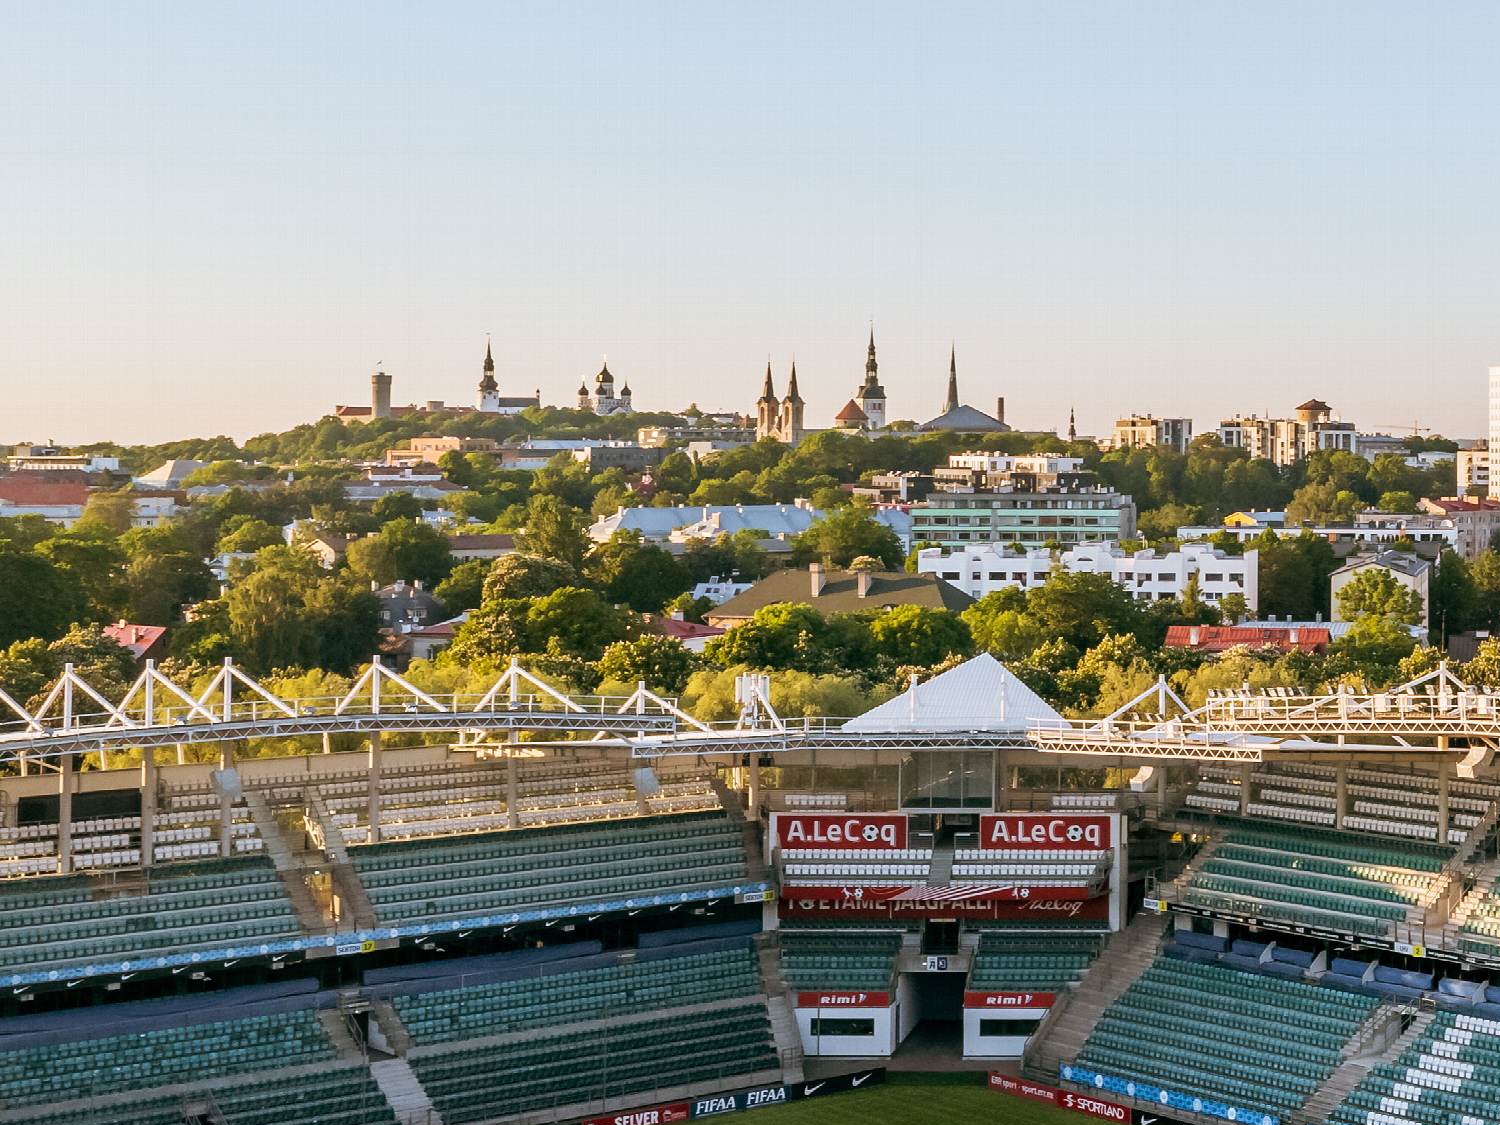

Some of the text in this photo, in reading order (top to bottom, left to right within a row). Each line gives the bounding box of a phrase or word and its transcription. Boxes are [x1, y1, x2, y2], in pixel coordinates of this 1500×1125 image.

[696, 1096, 736, 1114] FIFAA
[747, 1088, 786, 1105] FIFAA
[1077, 1098, 1125, 1119] SPORTLAND
